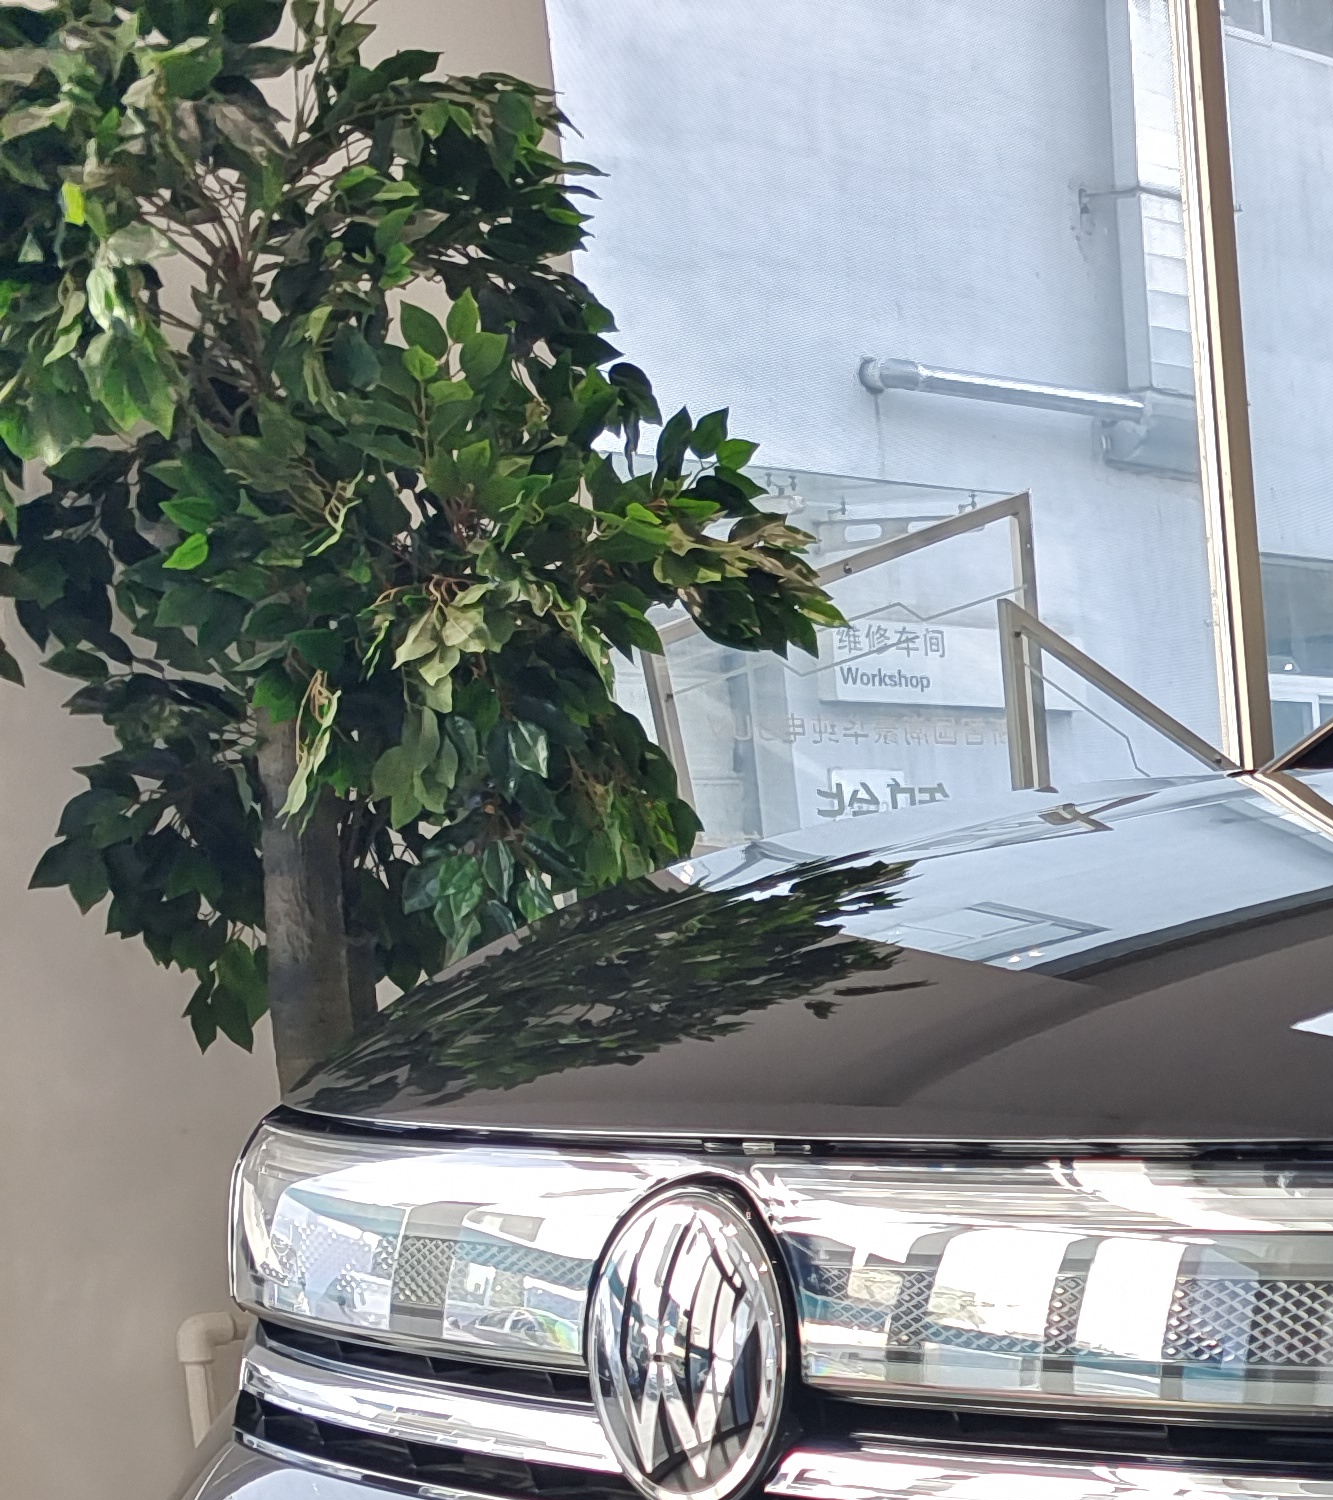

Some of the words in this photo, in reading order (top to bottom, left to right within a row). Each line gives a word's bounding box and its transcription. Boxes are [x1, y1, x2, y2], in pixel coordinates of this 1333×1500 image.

[837, 624, 946, 658] 维修车间
[840, 666, 931, 692] Workshop
